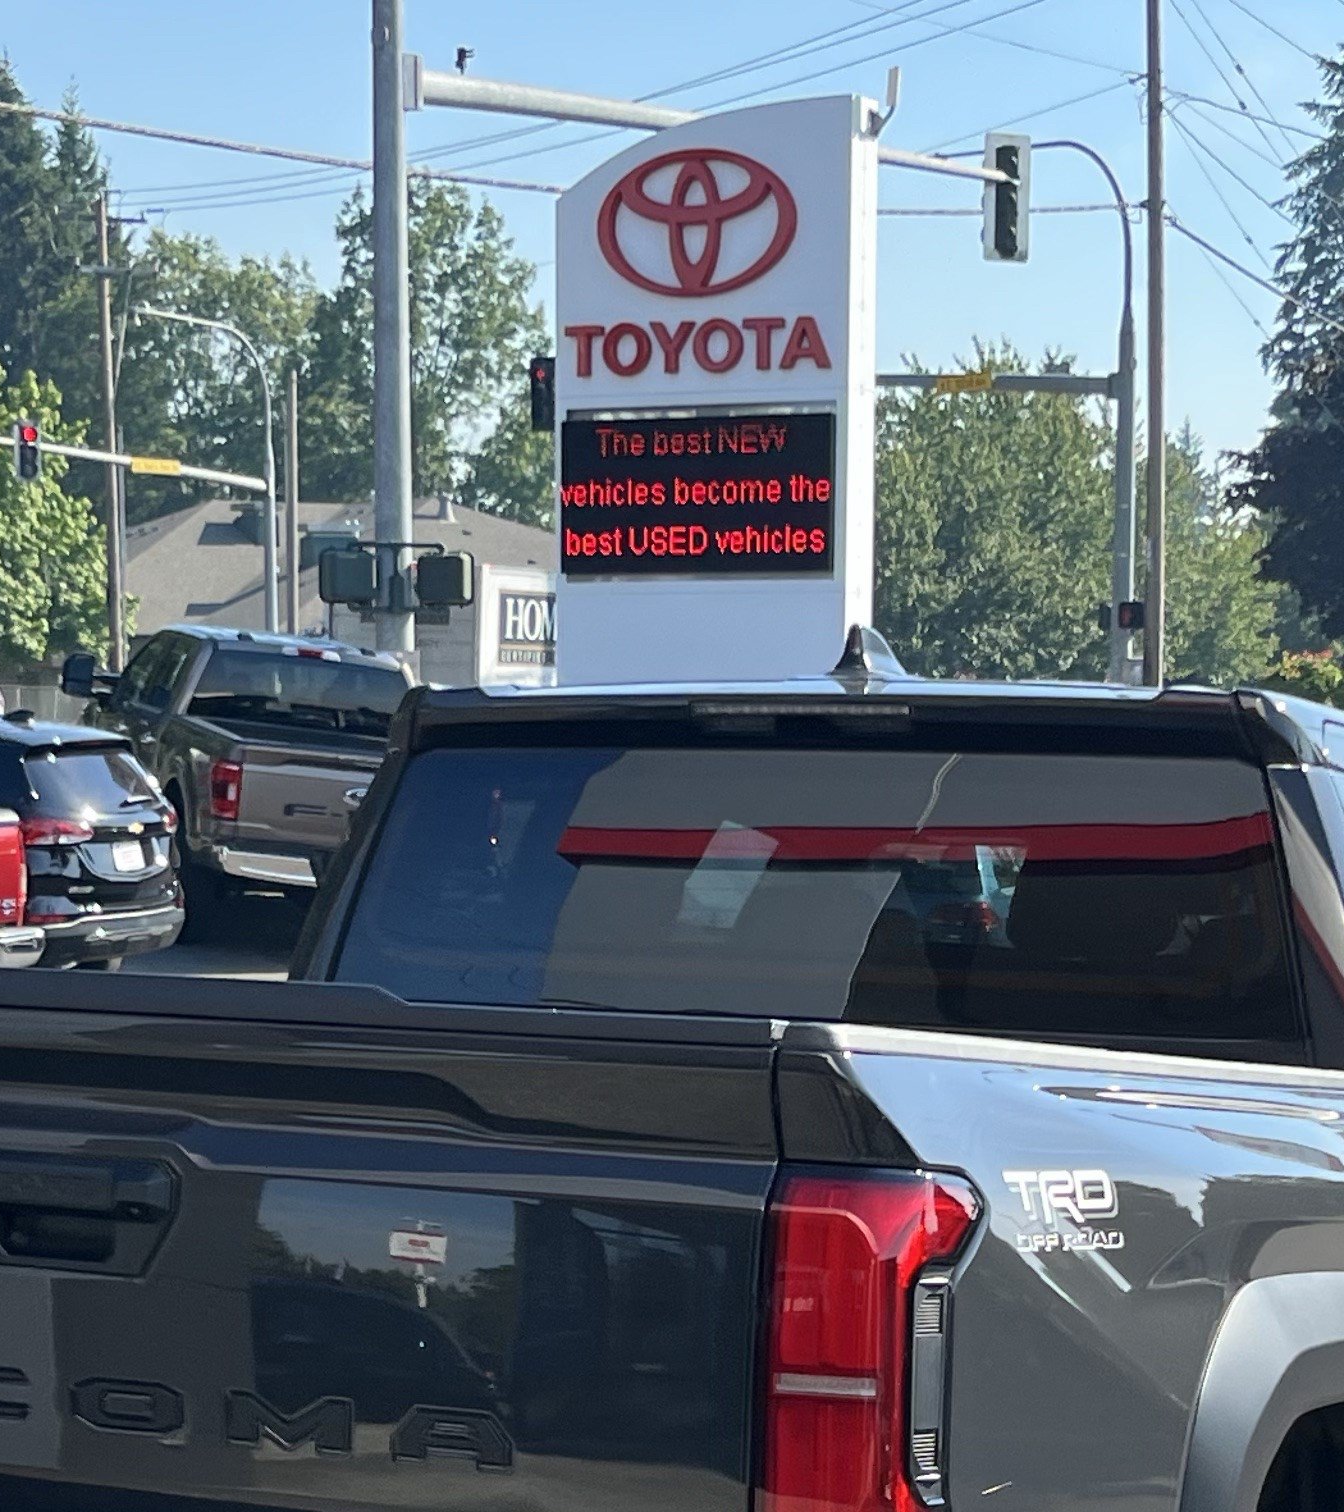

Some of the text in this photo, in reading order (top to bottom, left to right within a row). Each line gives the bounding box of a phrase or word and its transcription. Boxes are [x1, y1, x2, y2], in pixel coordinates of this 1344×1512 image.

[564, 316, 832, 378] TOYOTA
[595, 423, 788, 458] The best NEW
[560, 473, 832, 508] vehicles become the
[565, 523, 827, 557] best USED vehicles
[504, 597, 557, 641] HOM
[1002, 1170, 1114, 1224] TRD
[1016, 1233, 1060, 1252] OFF
